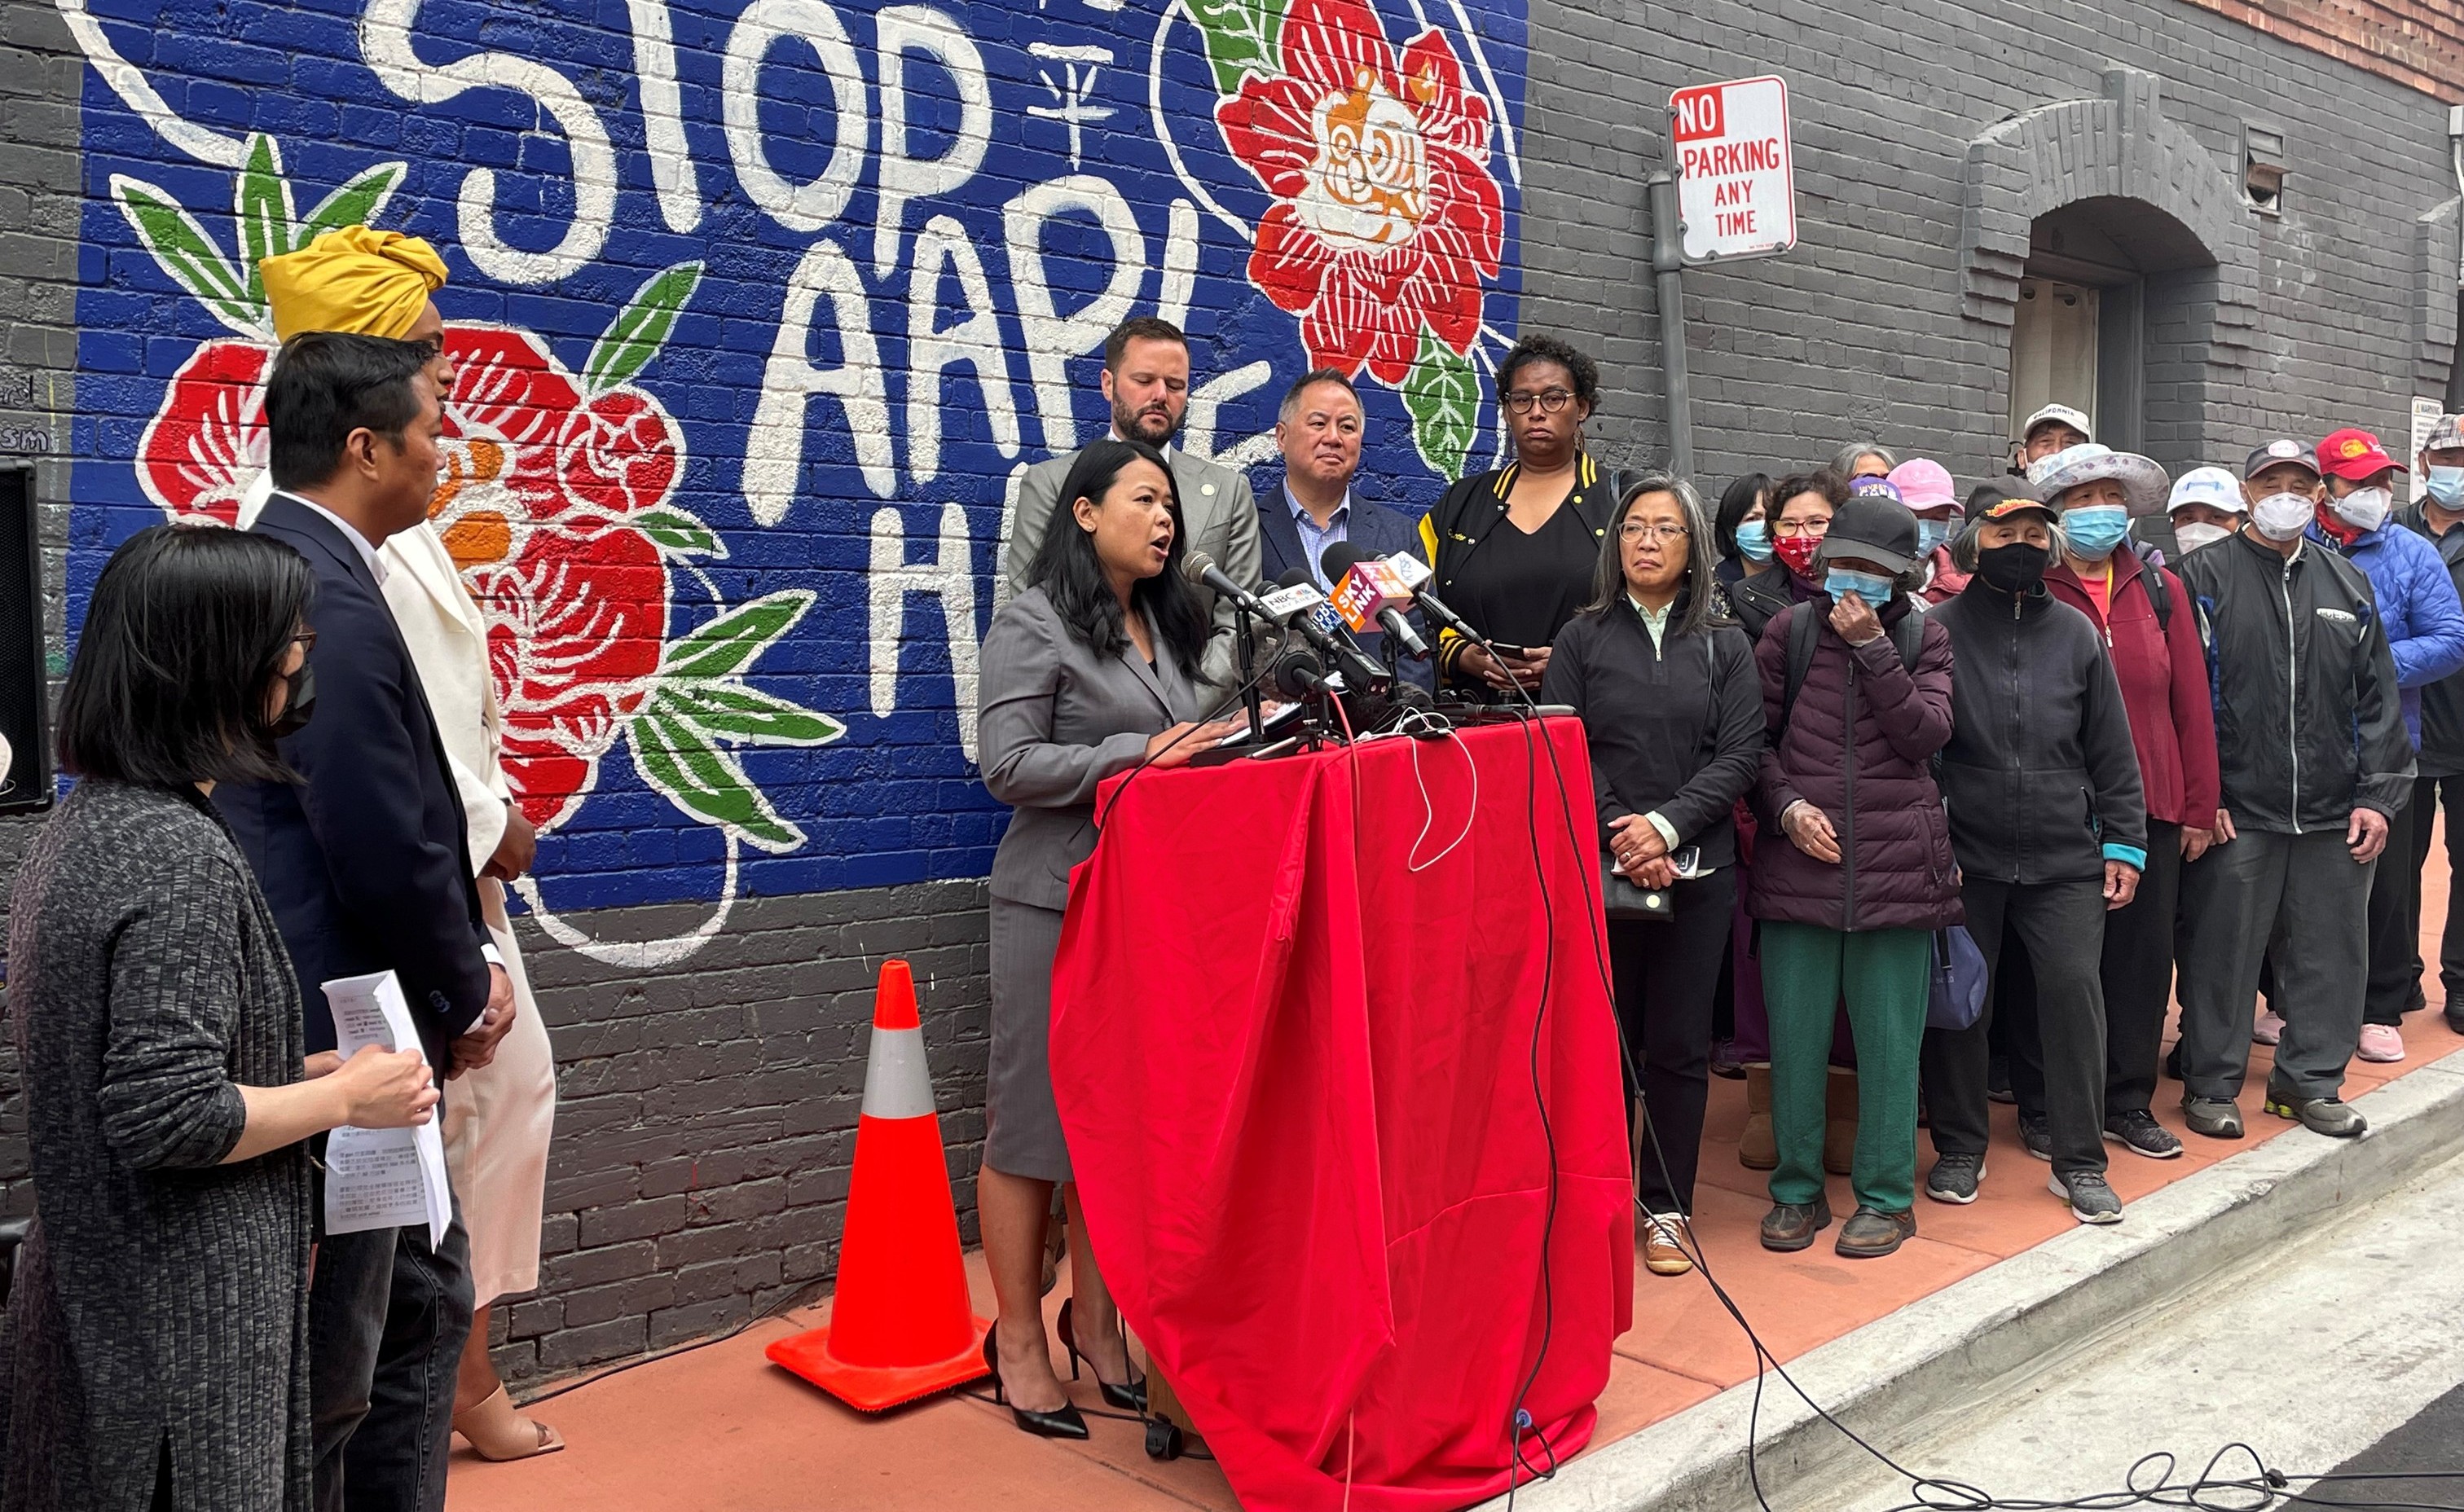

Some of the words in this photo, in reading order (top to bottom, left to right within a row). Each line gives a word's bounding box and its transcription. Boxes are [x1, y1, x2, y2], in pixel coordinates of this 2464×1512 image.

[1026, 0, 1125, 172] 平
[1677, 93, 1717, 135] NO
[1683, 137, 1780, 179] PARKING
[1714, 179, 1753, 207] ANY
[1714, 209, 1758, 238] TIME
[741, 174, 1199, 527] AAPI
[2034, 407, 2075, 420] CALIFORNIA
[1268, 592, 1296, 606] NBC
[1337, 573, 1363, 609] SKY
[1344, 583, 1376, 623] LINK
